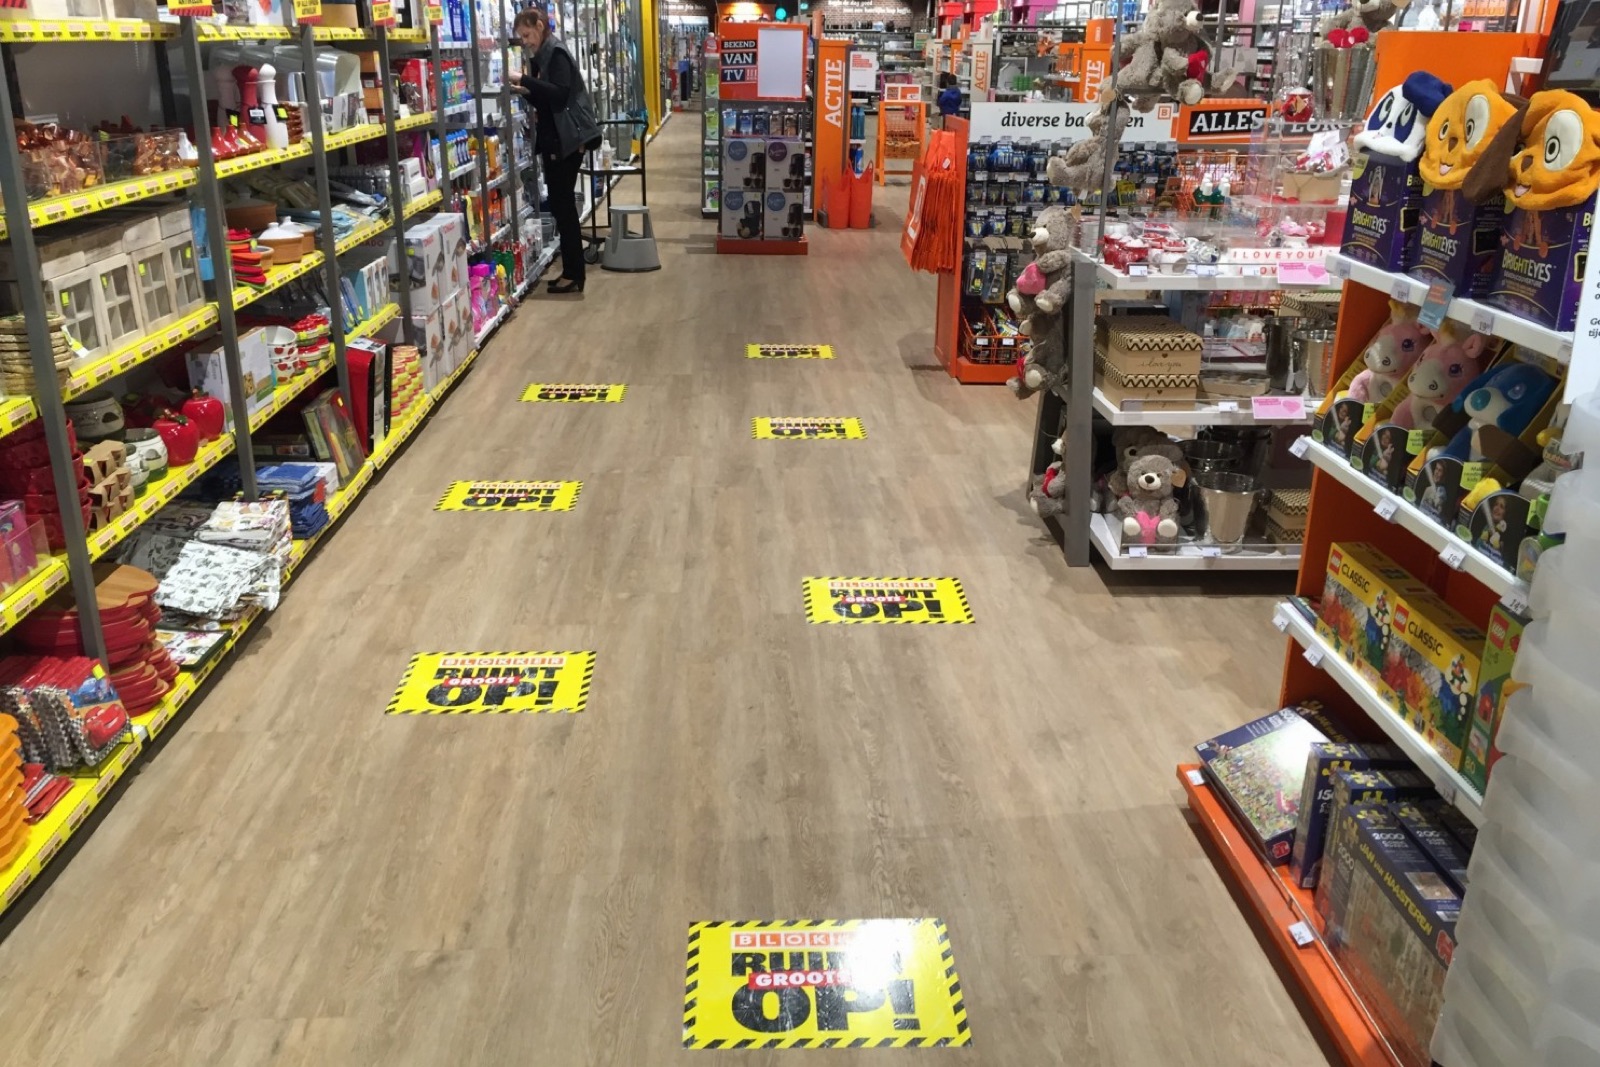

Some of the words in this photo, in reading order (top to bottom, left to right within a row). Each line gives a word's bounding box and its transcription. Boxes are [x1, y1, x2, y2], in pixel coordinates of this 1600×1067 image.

[724, 53, 753, 64] VAN
[724, 69, 744, 81] TV
[975, 51, 986, 91] ACTIE
[1084, 60, 1102, 103] CTIE
[825, 58, 842, 128] ACTIE
[1001, 111, 1060, 128] diverse
[1191, 110, 1265, 133] ALLES
[1502, 249, 1553, 283] BRIGHTEYES
[462, 495, 558, 508] OP!
[1341, 563, 1371, 594] CLASSIC
[830, 589, 937, 599] RUIMT
[833, 599, 945, 619] OP!
[1408, 621, 1444, 656] CLASSIC
[441, 657, 565, 666] BLOKKER
[433, 666, 564, 680] RUIMT
[449, 676, 517, 686] GROOTS
[426, 680, 560, 707] OP!
[1372, 833, 1405, 841] 2000
[1360, 843, 1375, 864] JAN
[1384, 872, 1433, 936] HAASTEREN
[731, 979, 921, 1033] OP!
